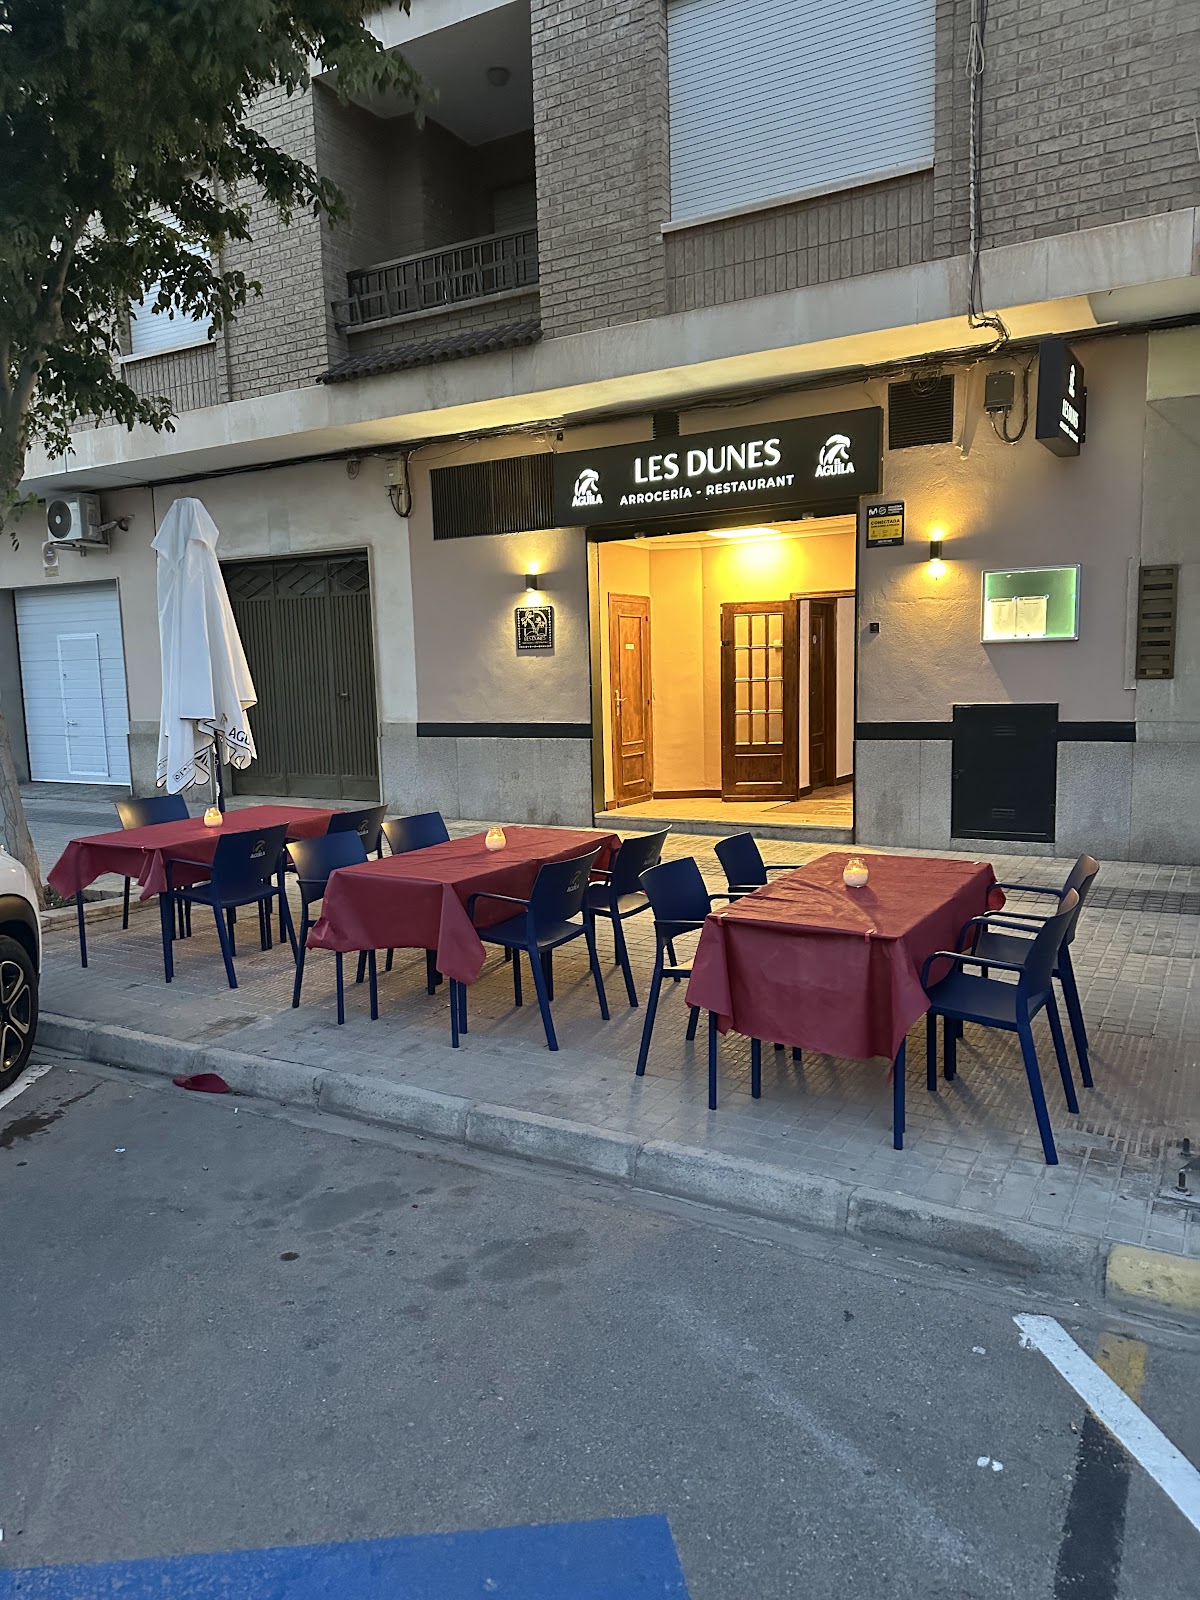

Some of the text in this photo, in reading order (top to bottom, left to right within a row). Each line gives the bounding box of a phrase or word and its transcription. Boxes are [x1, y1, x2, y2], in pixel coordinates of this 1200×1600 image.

[634, 438, 781, 483] LES DUNES
[619, 486, 693, 506] ARROCERÍA
[706, 474, 795, 496] RESTAURANT
